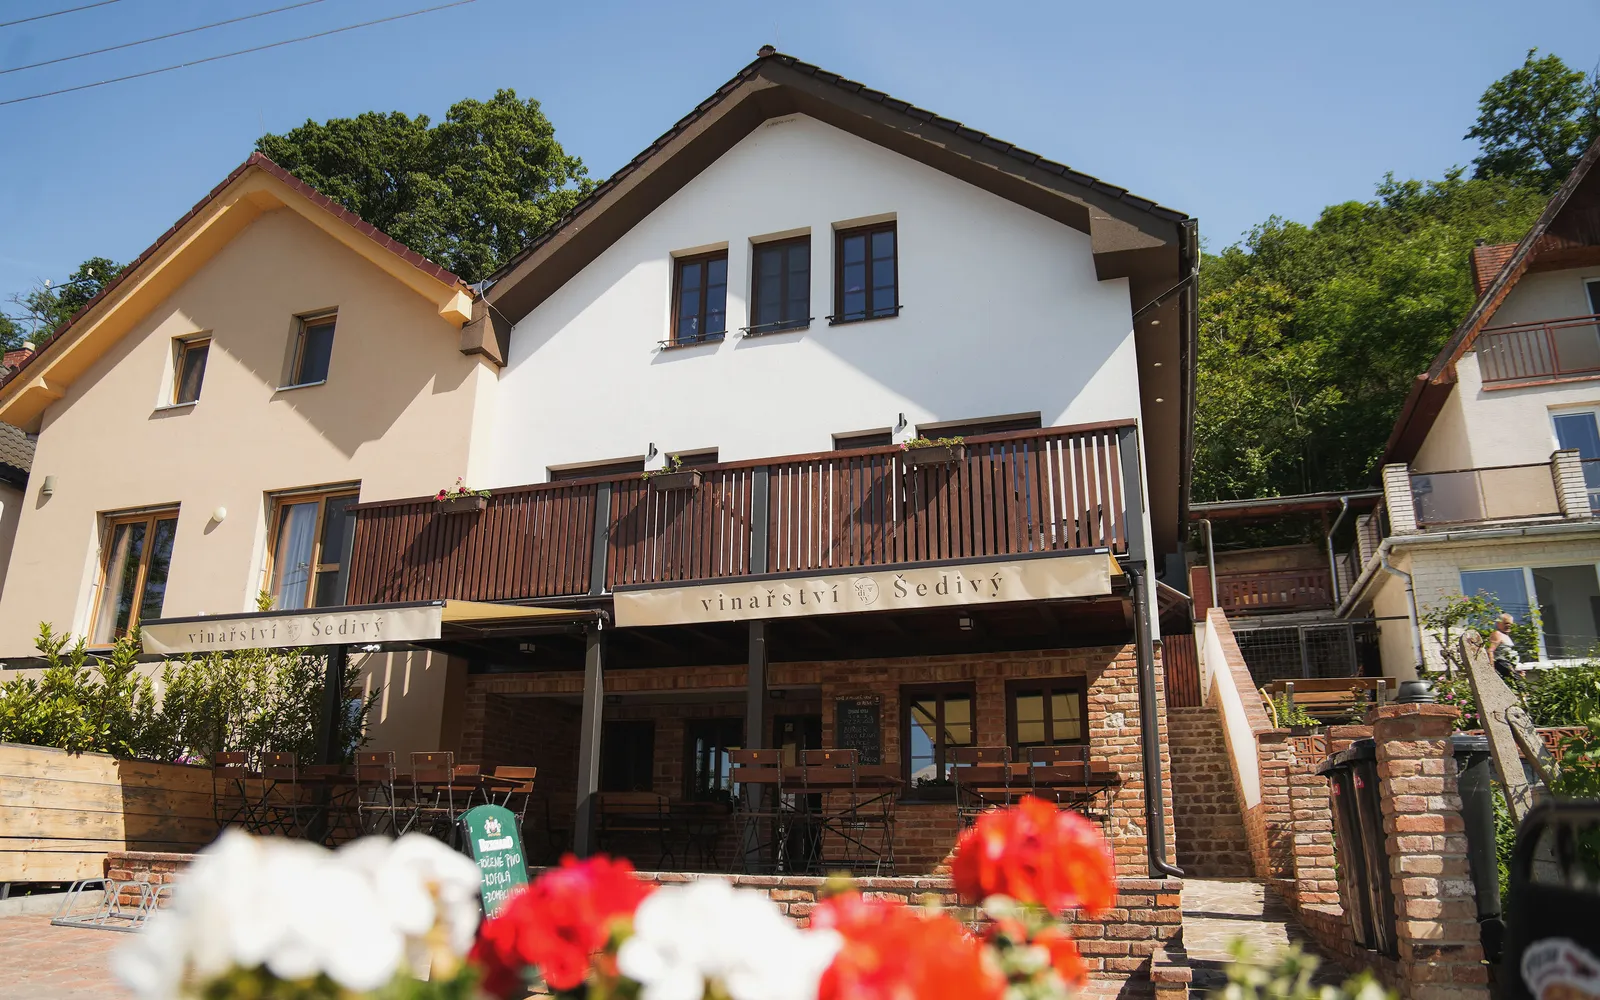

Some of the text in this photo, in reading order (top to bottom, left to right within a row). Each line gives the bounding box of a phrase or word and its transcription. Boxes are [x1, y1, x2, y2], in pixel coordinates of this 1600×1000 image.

[701, 573, 1003, 612] vinařství Šedivý
[188, 623, 278, 644] vinařství
[311, 616, 384, 637] Šedivý
[503, 853, 521, 868] PIVO
